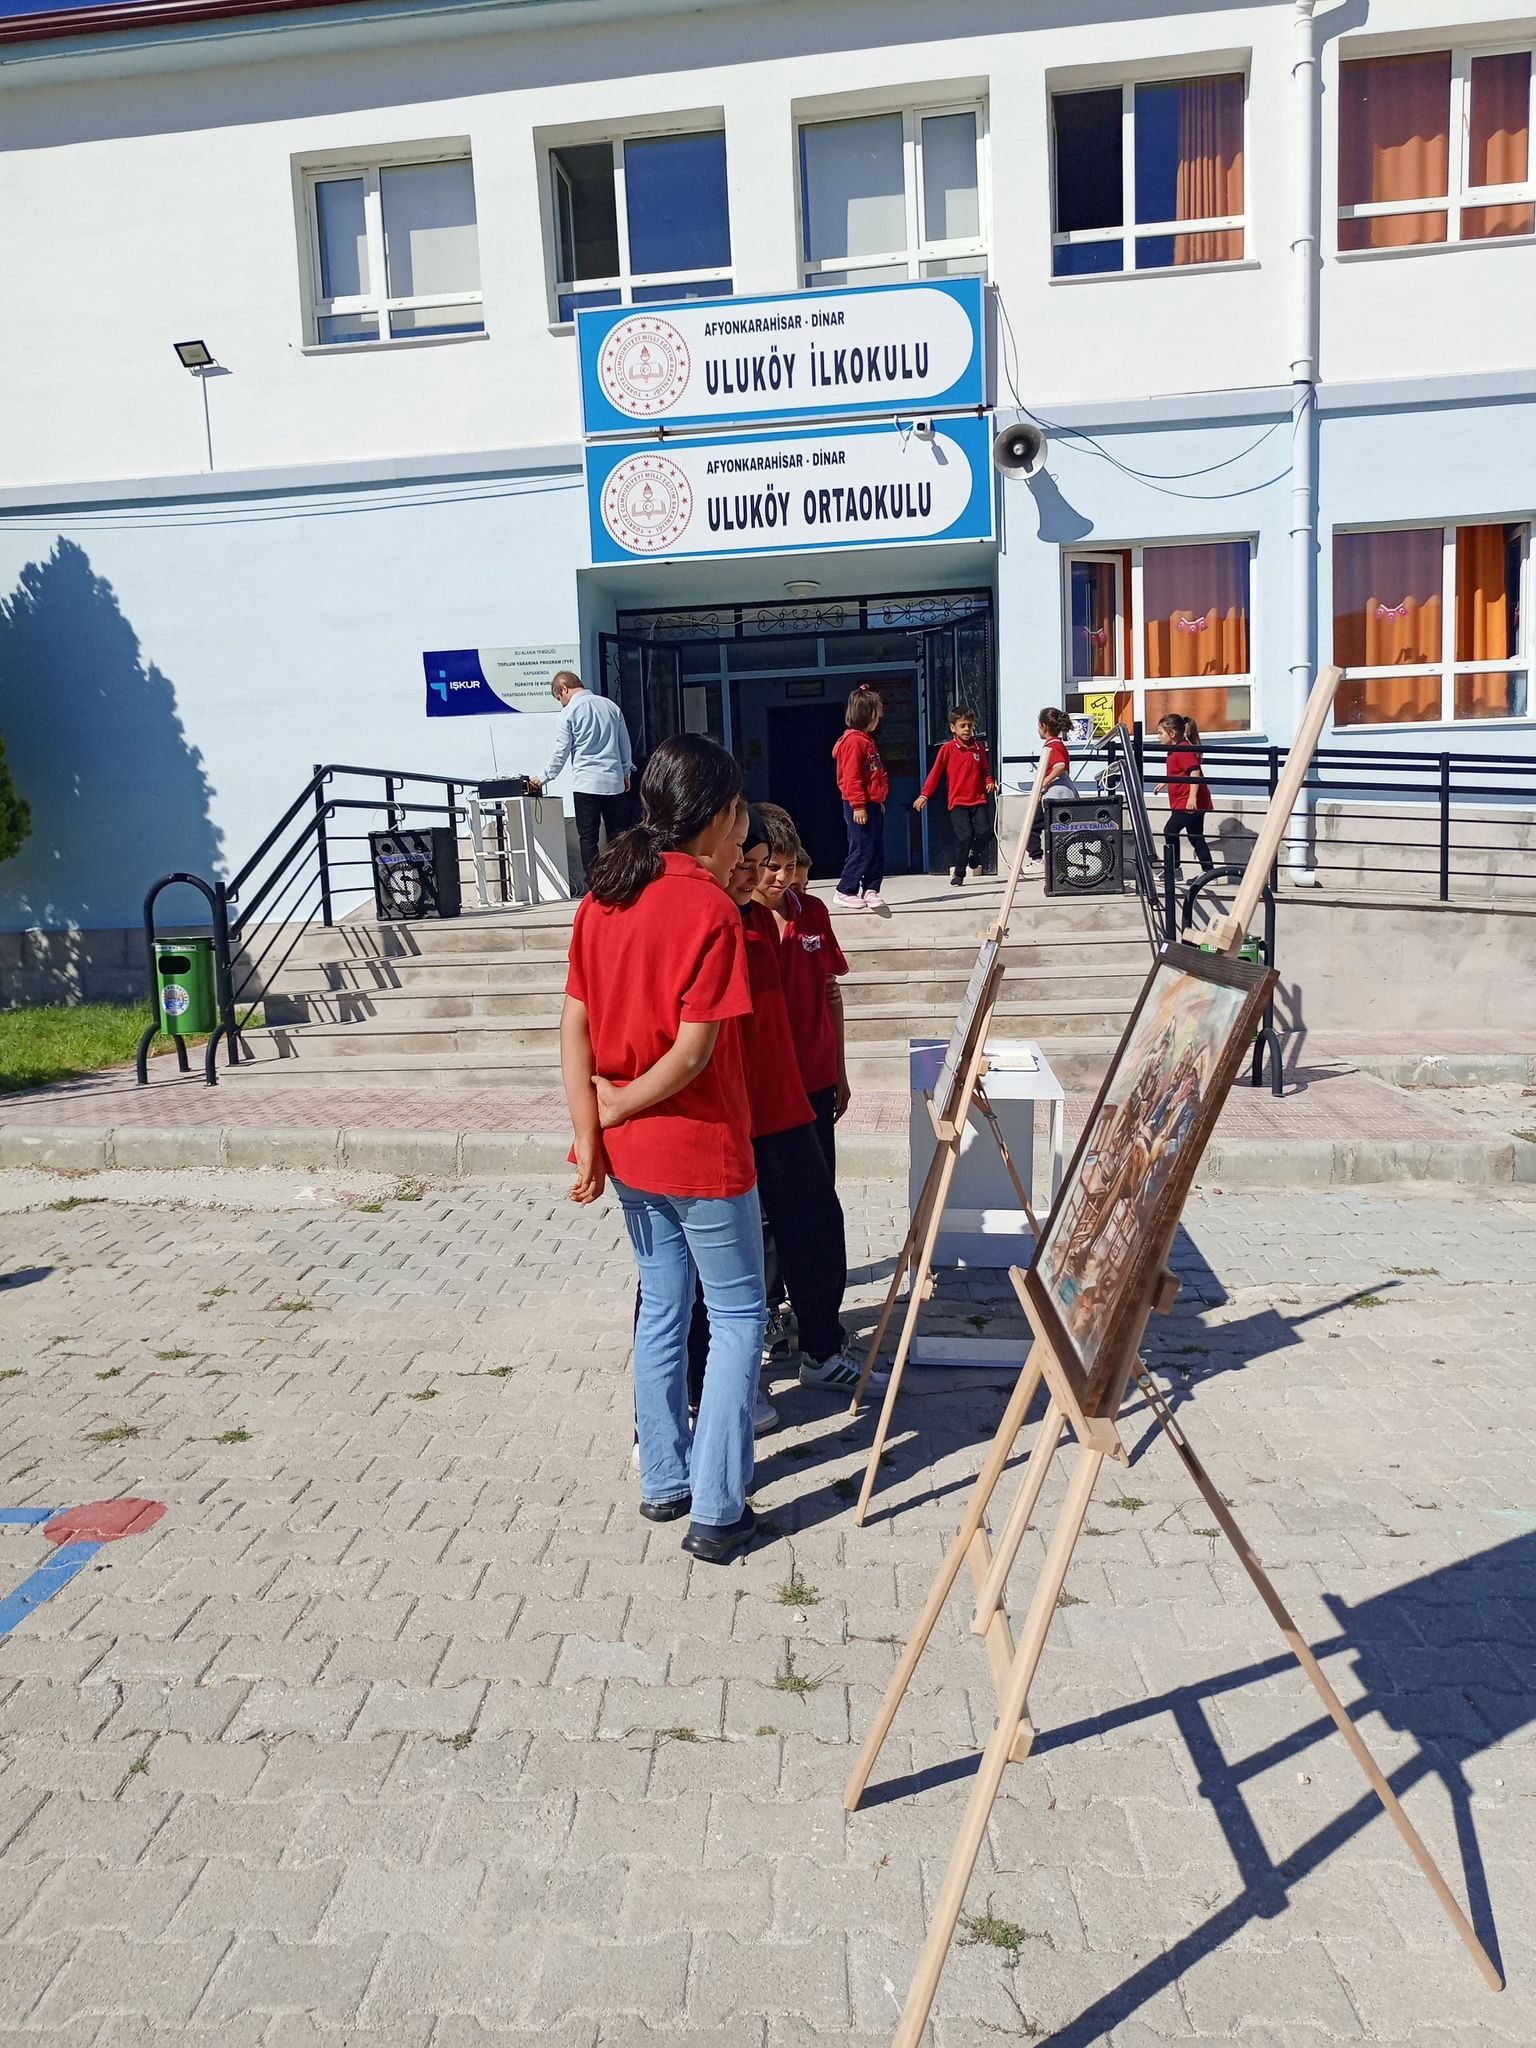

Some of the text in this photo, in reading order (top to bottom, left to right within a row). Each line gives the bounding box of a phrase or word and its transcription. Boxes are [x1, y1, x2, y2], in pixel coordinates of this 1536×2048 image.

[704, 313, 802, 336] AFYONKARAHİSAR
[811, 309, 845, 327] DİNAR
[705, 341, 929, 395] ULUKÖY İLKOKULU
[706, 452, 803, 475] AFYONKARAHİSAR
[812, 449, 846, 466] DİNAR
[707, 482, 931, 532] ULUKÖY ORTAOKULU
